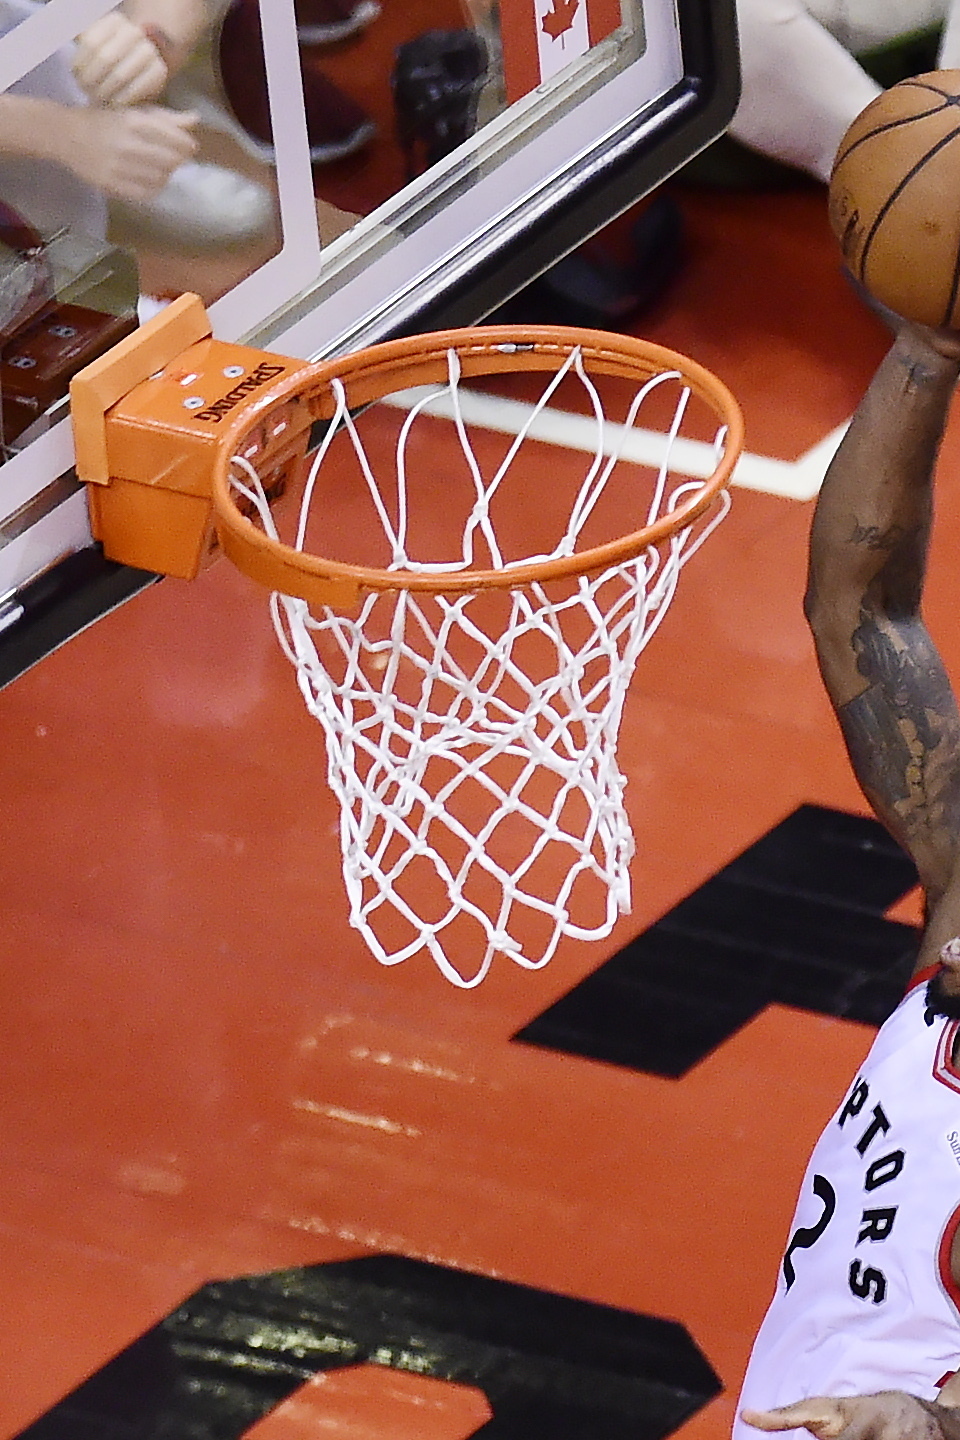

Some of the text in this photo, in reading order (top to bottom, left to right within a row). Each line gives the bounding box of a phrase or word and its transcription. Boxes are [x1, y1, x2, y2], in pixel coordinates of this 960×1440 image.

[193, 362, 286, 423] SPALDING
[783, 1174, 837, 1296] 2
[837, 1076, 908, 1306] PTORS
